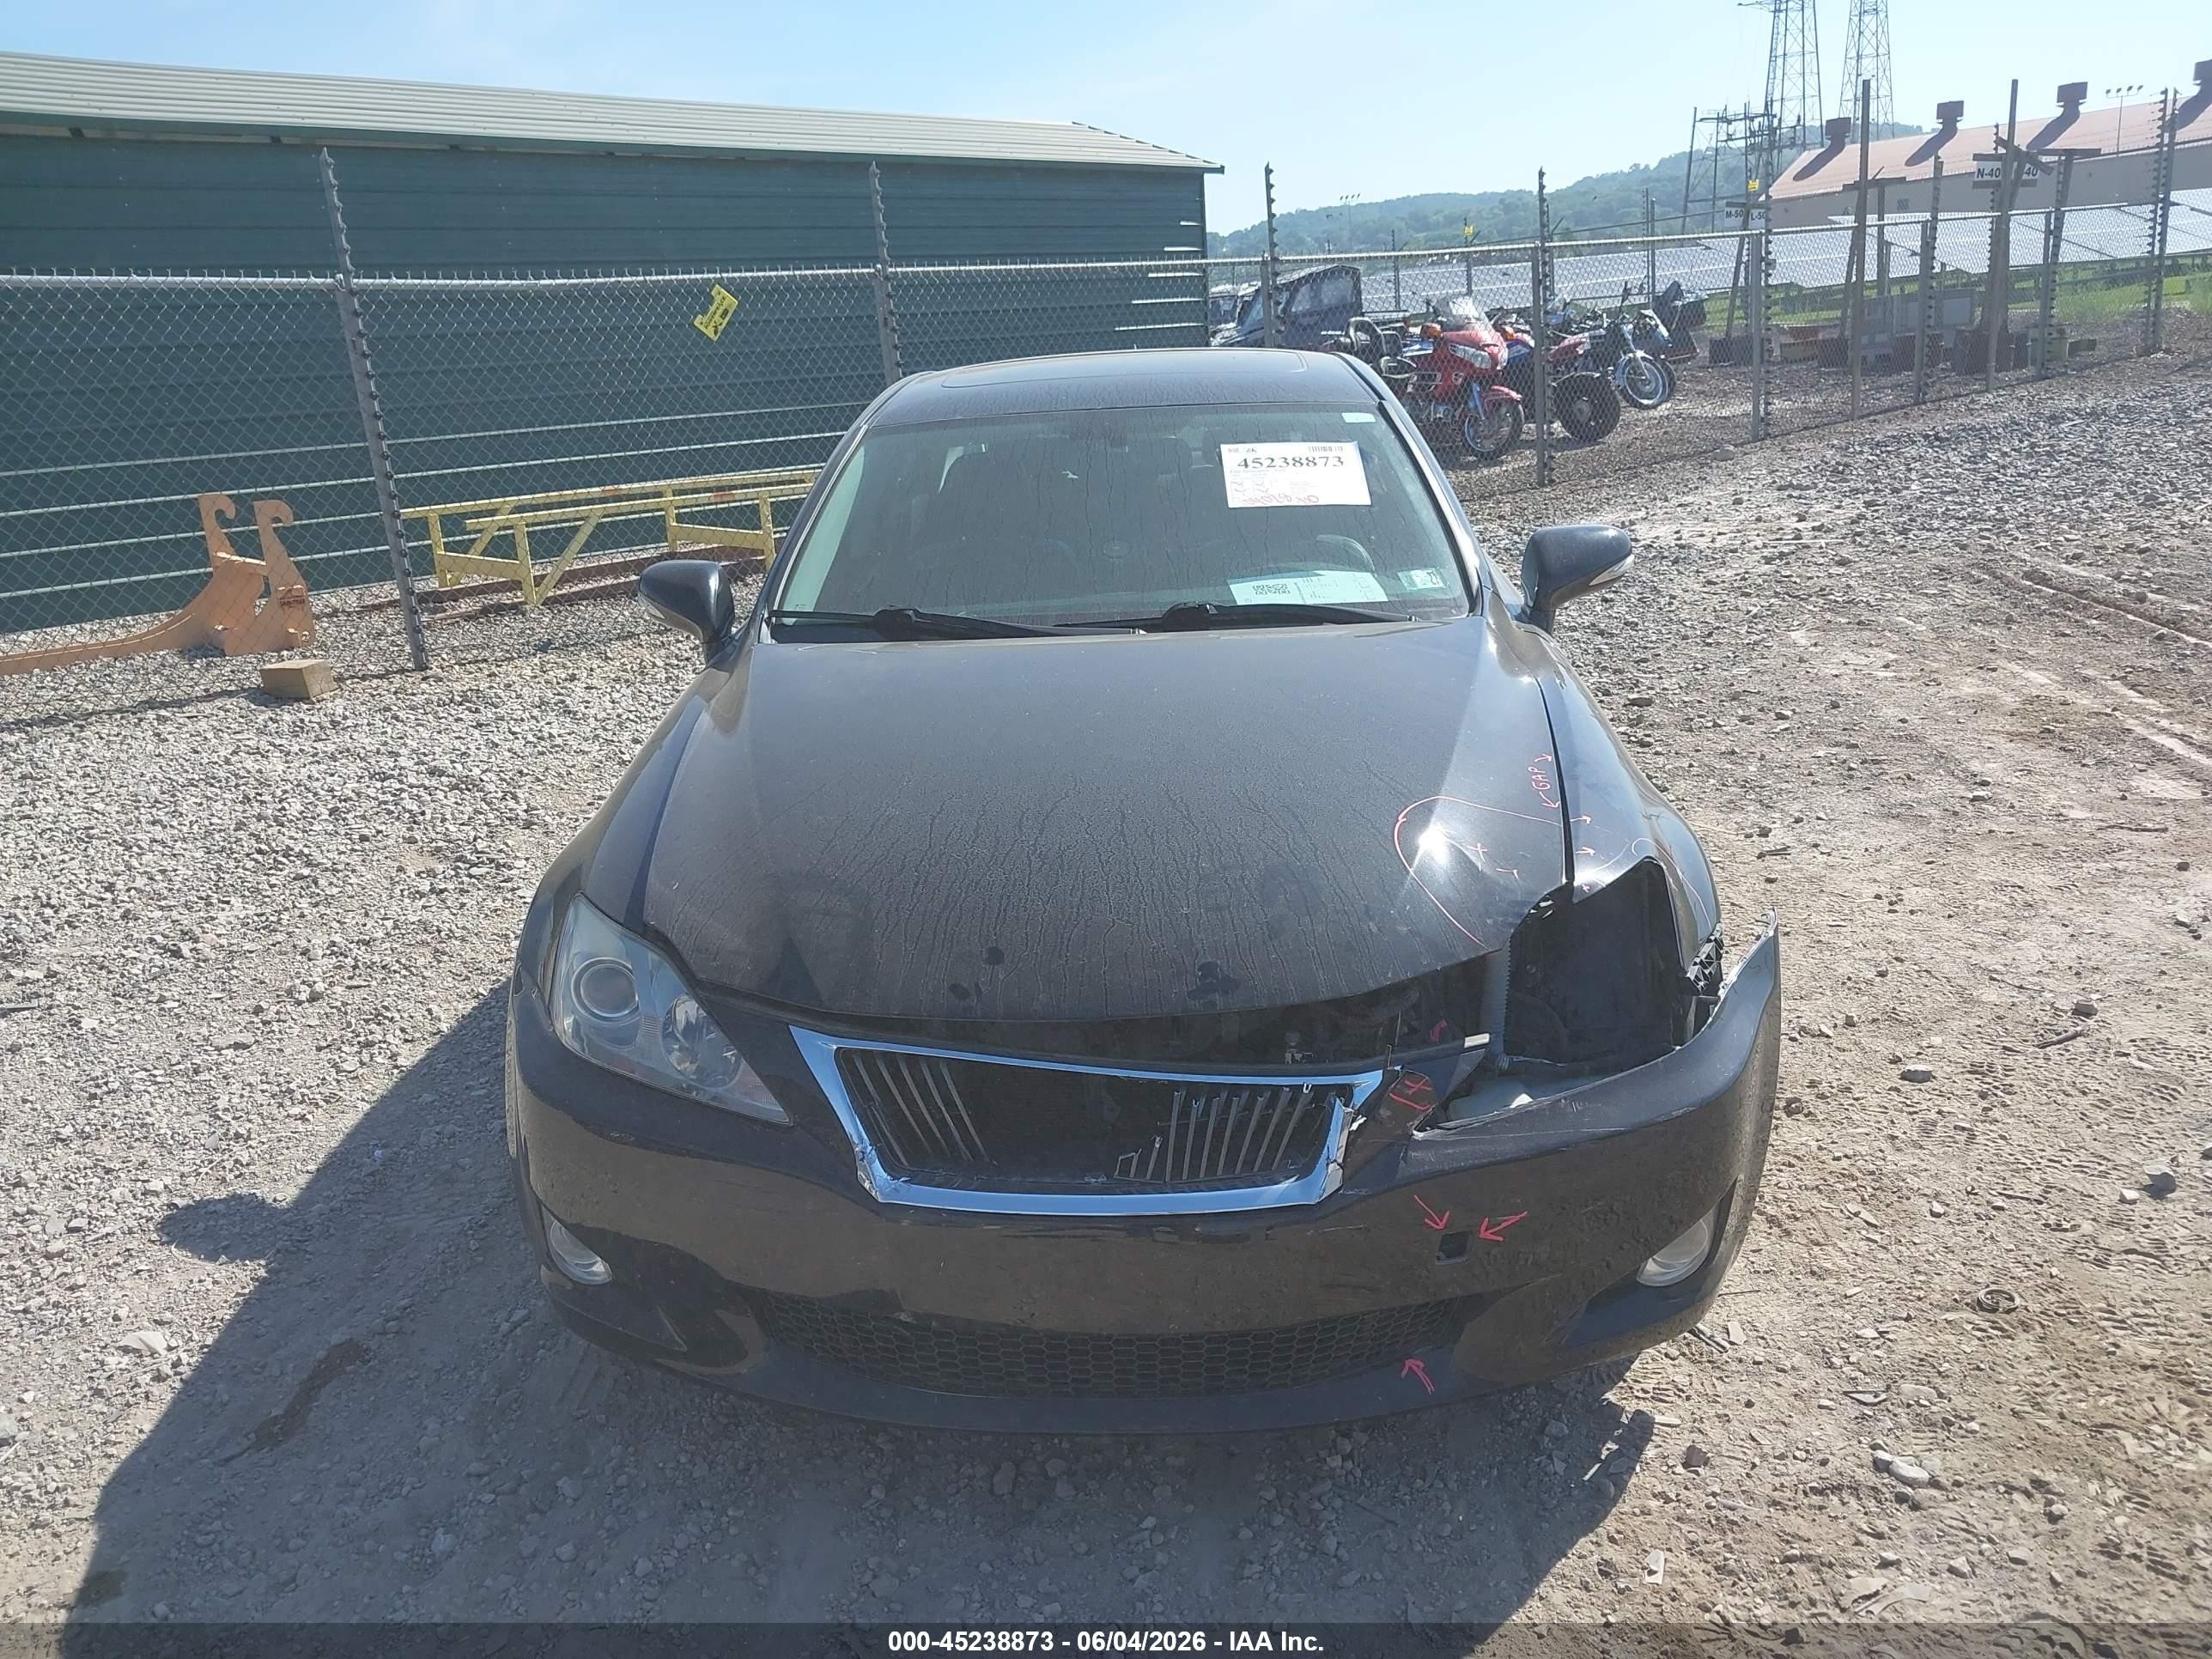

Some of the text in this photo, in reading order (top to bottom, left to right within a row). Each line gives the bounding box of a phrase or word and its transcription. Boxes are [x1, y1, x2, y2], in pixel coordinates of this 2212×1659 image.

[1976, 167, 2002, 179] N-40
[1725, 210, 1744, 219] M-50
[1237, 455, 1345, 469] 45238873
[1528, 766, 1551, 790] GAP
